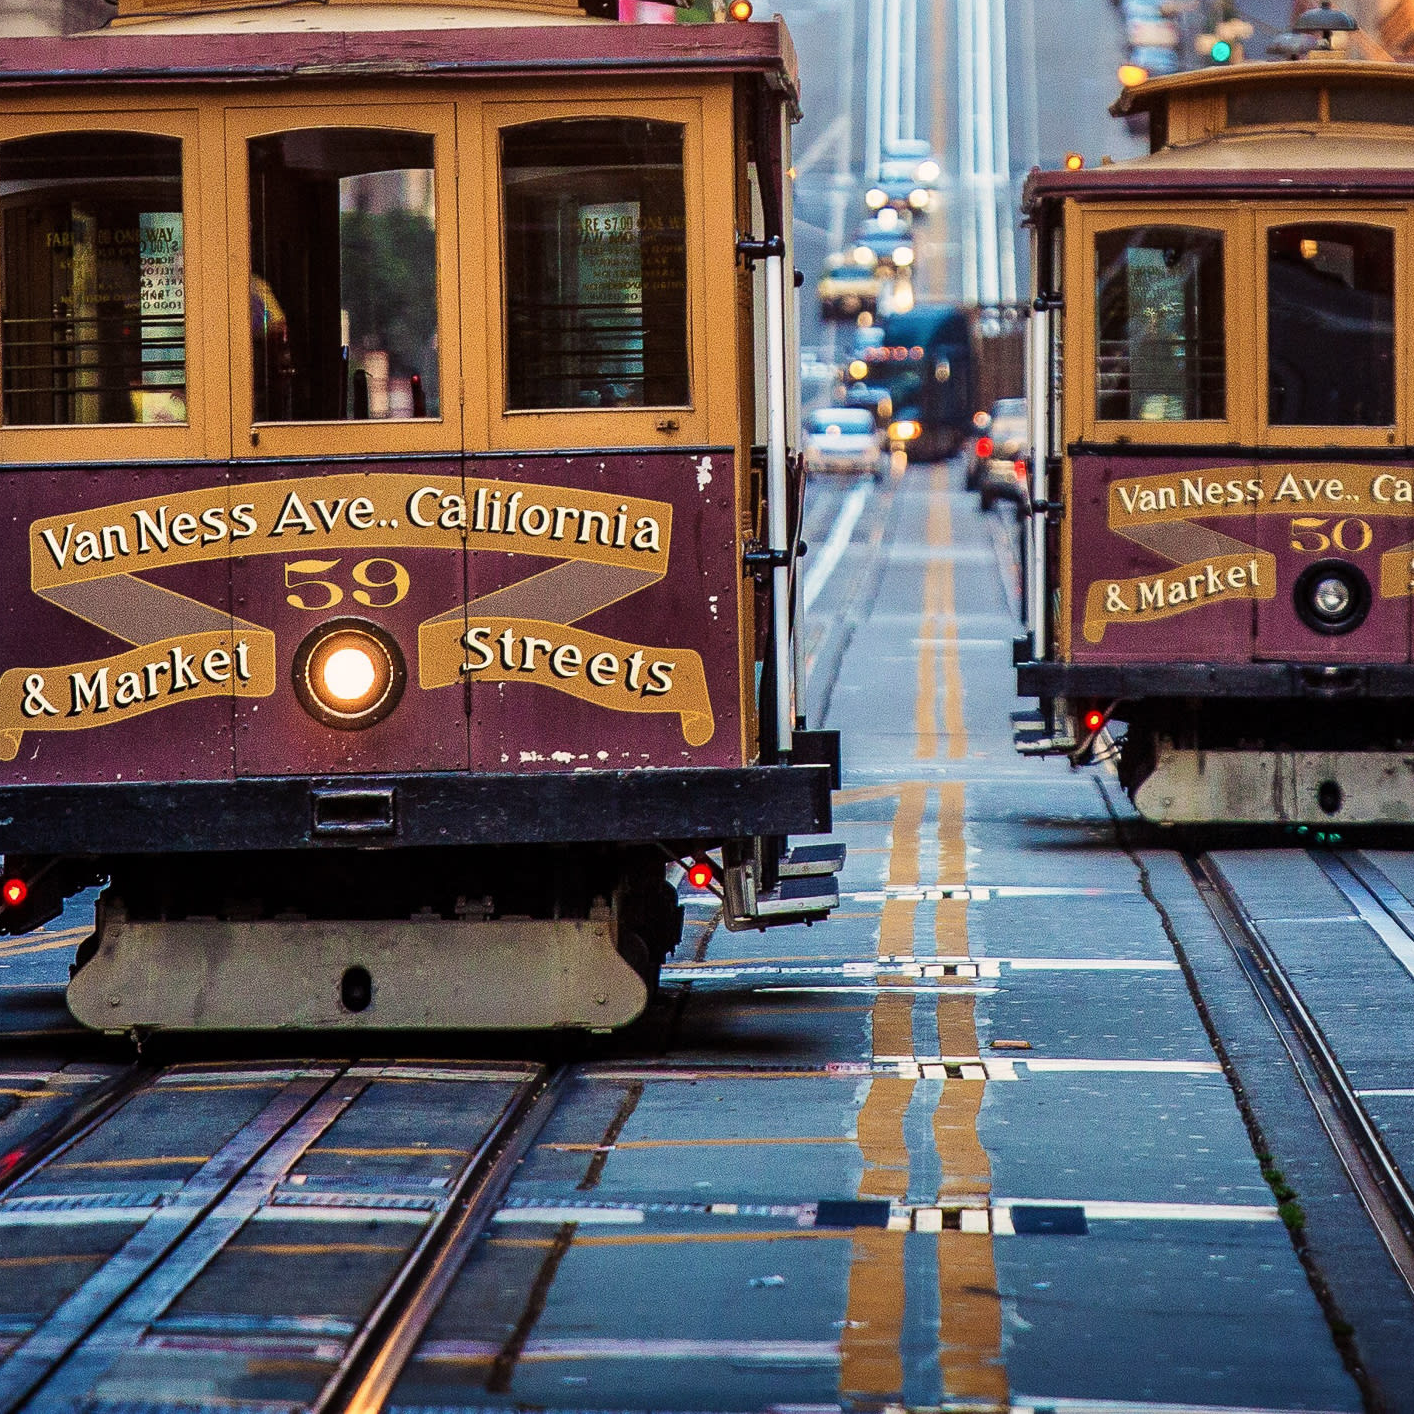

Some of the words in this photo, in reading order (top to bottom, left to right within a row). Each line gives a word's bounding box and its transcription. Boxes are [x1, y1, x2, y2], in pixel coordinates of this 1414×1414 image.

[406, 486, 661, 553] California
[1290, 517, 1373, 552] 50
[285, 557, 410, 610] 59
[1105, 583, 1131, 612] &
[1137, 559, 1261, 612] Market
[21, 673, 59, 717] &
[70, 640, 253, 714] Market
[459, 626, 676, 698] Streets
